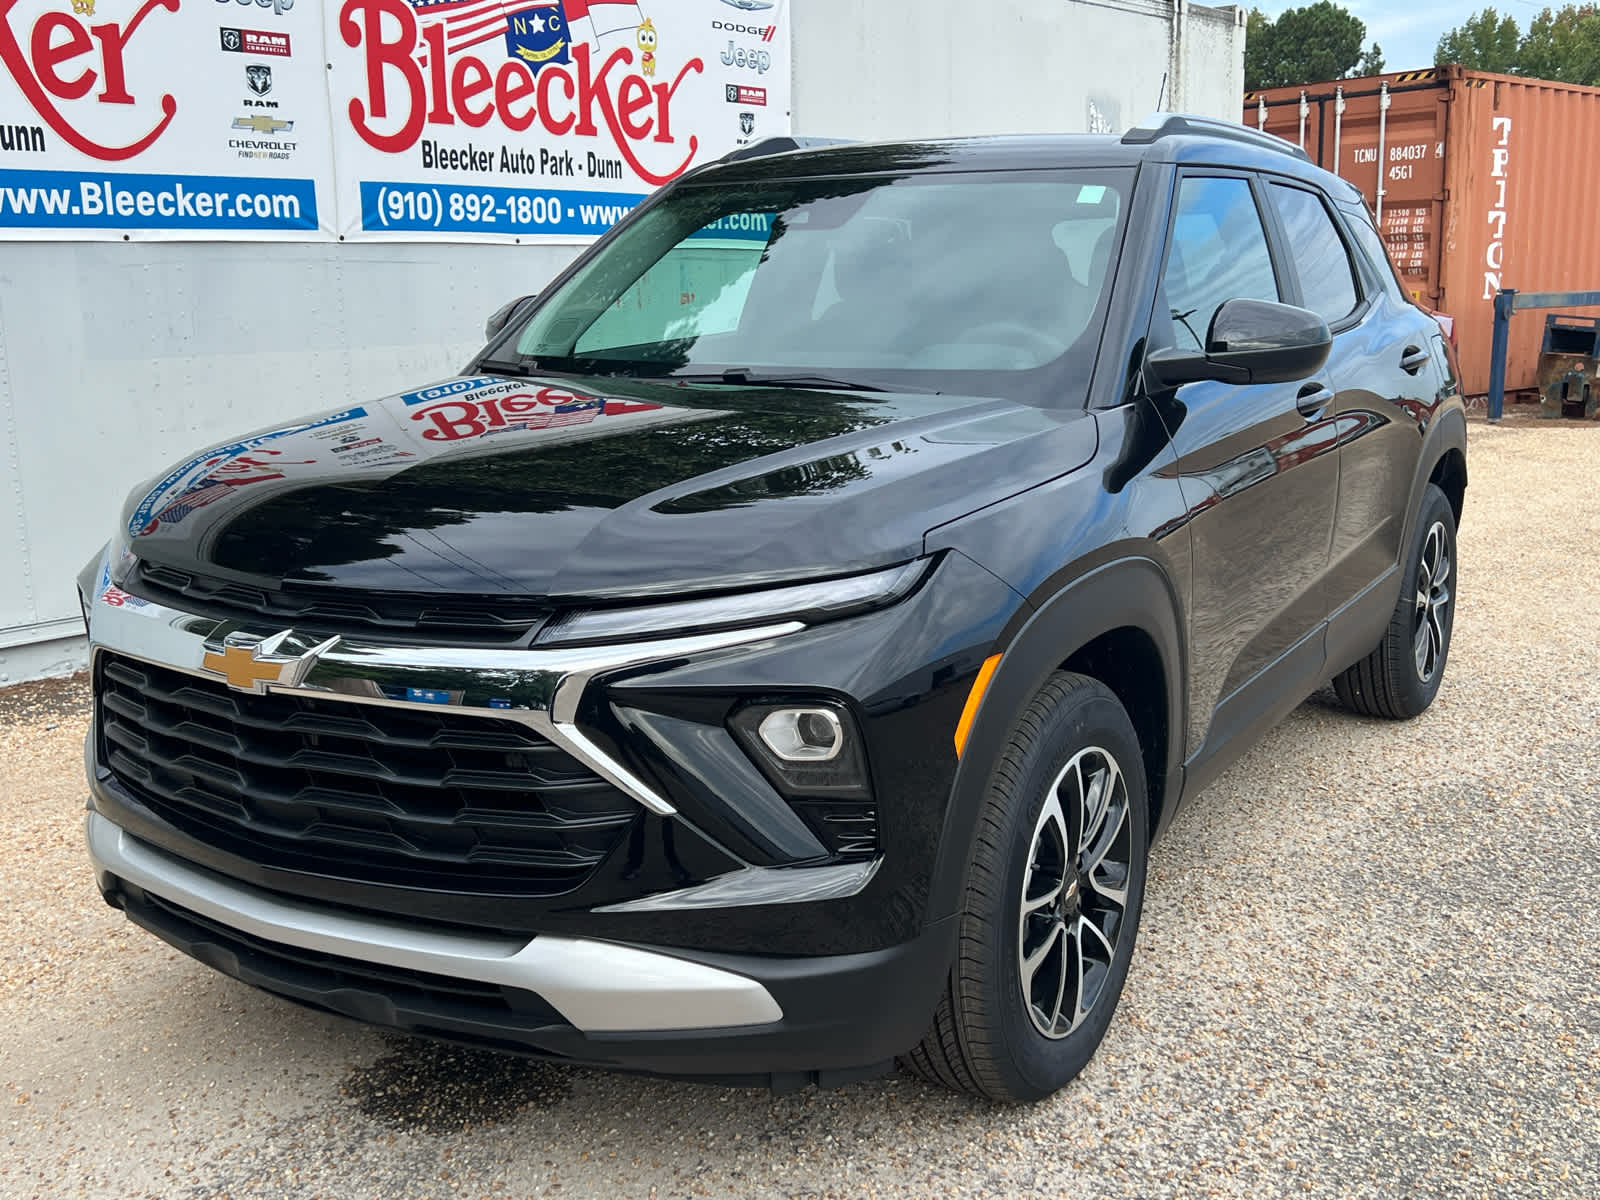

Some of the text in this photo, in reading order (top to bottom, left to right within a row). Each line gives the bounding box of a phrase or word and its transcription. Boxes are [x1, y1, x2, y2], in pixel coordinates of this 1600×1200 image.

[245, 33, 286, 45] RAM
[712, 21, 768, 36] DODGE
[720, 40, 770, 74] Jeep
[243, 99, 278, 108] RAM
[339, 0, 704, 186] Bleecker
[228, 139, 296, 150] CHEVROLET
[1353, 141, 1443, 164] TCNU 884037 4
[421, 140, 622, 179] Bleecker Auto Park Dunn
[1389, 165, 1412, 180] 45G1
[0, 181, 301, 218] ww.Bleecker.com
[377, 186, 443, 227] (910)
[449, 192, 561, 224] 892-1800
